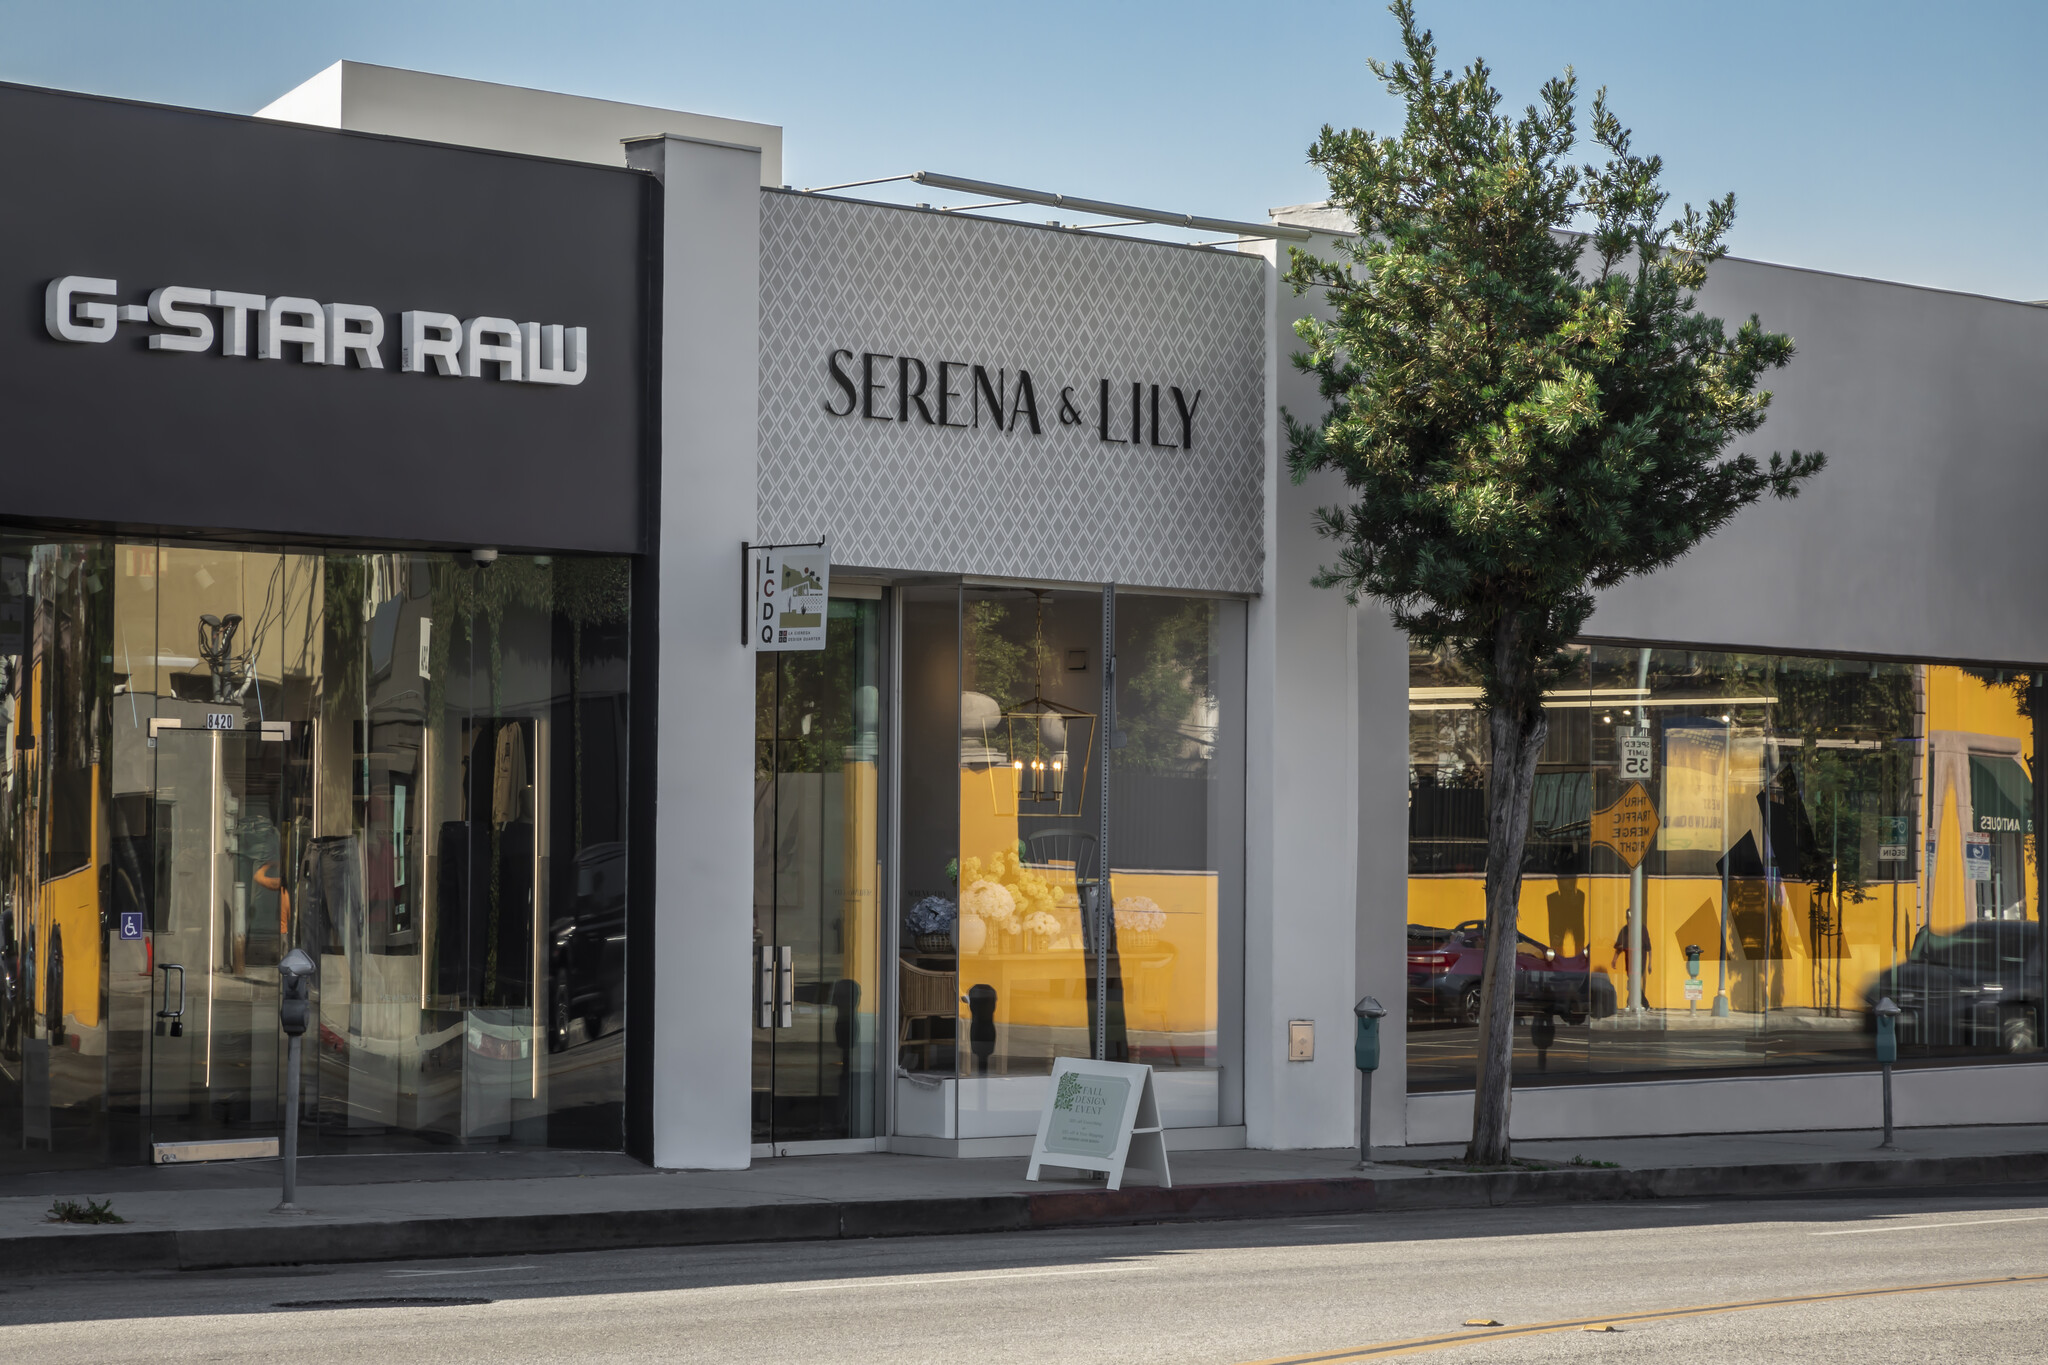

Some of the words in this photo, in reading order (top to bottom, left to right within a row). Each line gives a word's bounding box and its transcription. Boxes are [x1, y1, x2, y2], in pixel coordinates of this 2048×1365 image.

[45, 275, 384, 369] G-STAR
[401, 309, 587, 386] RAW
[825, 349, 1041, 435] SERENA
[1060, 386, 1082, 425] &
[1099, 379, 1201, 449] LILY
[208, 714, 232, 728] 8420
[1083, 1086, 1102, 1096] FALL
[1075, 1095, 1106, 1106] DESIGN
[1075, 1104, 1103, 1115] EVENT
